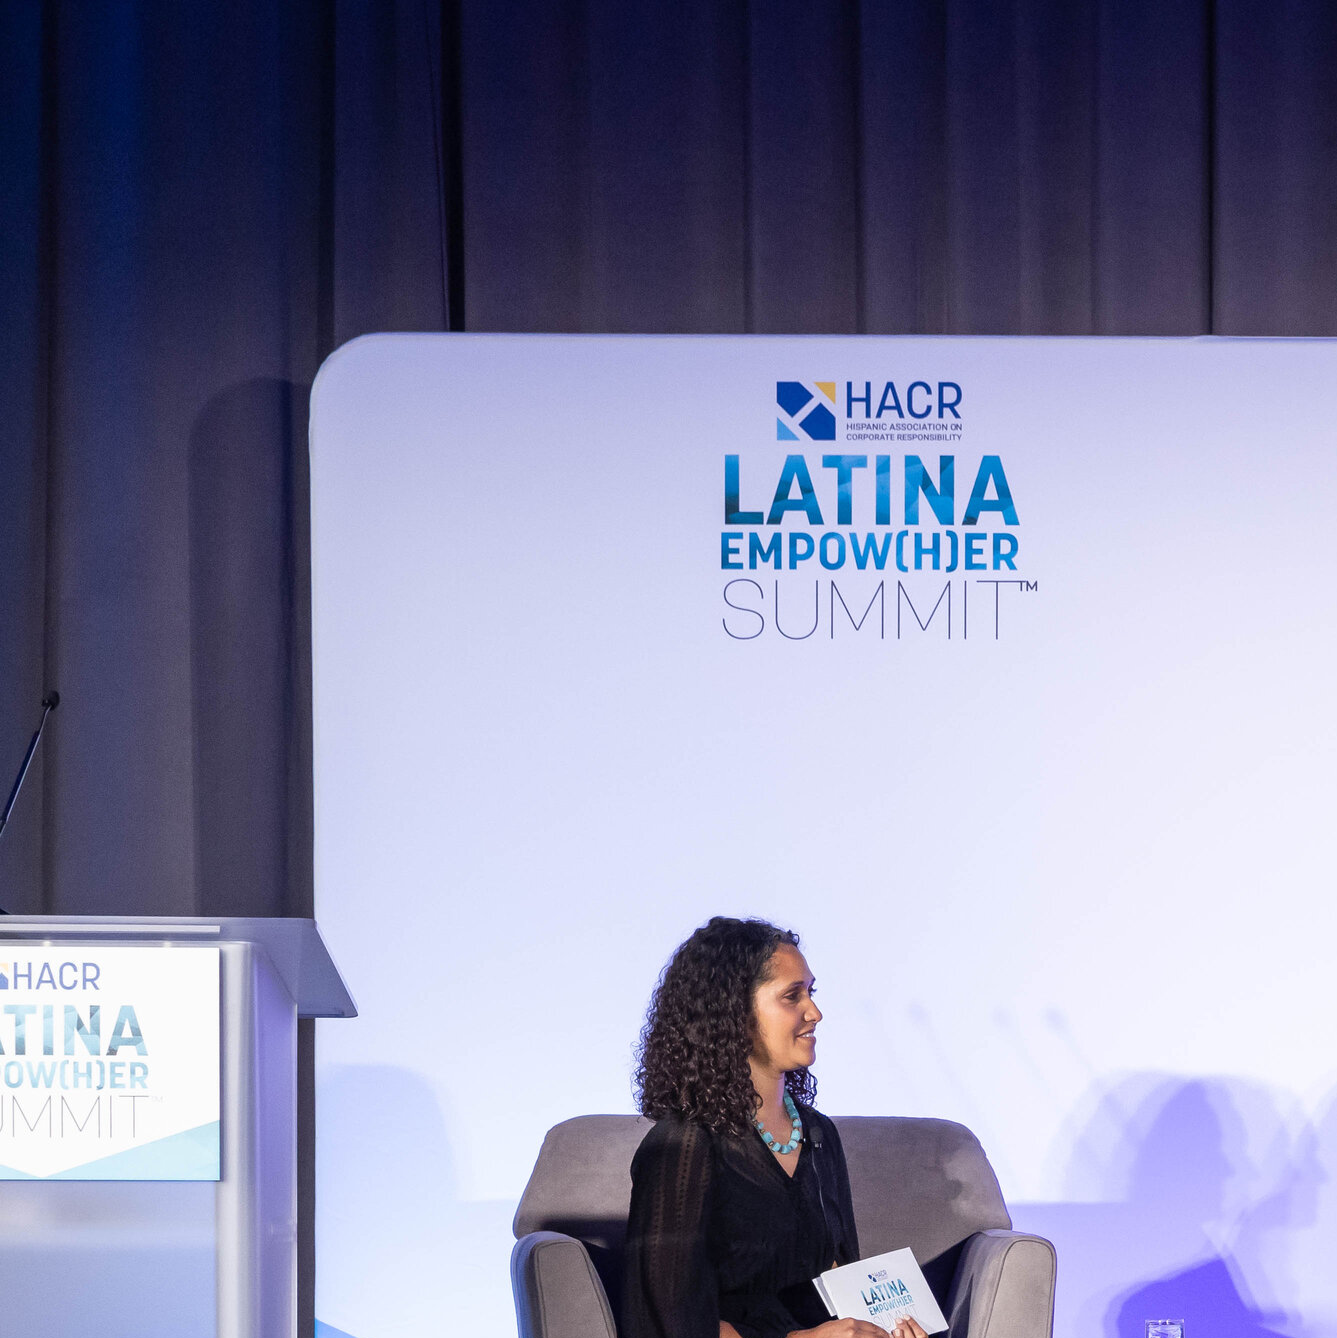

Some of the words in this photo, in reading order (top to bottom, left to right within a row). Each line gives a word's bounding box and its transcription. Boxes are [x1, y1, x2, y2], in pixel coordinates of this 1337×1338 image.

[846, 381, 963, 419] HACR
[846, 423, 888, 431] HISPANIC
[889, 423, 948, 431] ASSOCIATION
[950, 423, 963, 431] ON
[846, 433, 895, 441] CORPORATE
[897, 433, 962, 441] RESPONSIBILITY
[724, 455, 1020, 525] LATINA
[721, 530, 1019, 573] EMPOW(H)ER
[13, 962, 101, 990] HACR
[0, 1004, 149, 1056] TINA
[0, 1059, 149, 1090] OW(H)ER
[860, 1278, 910, 1306] LATINA
